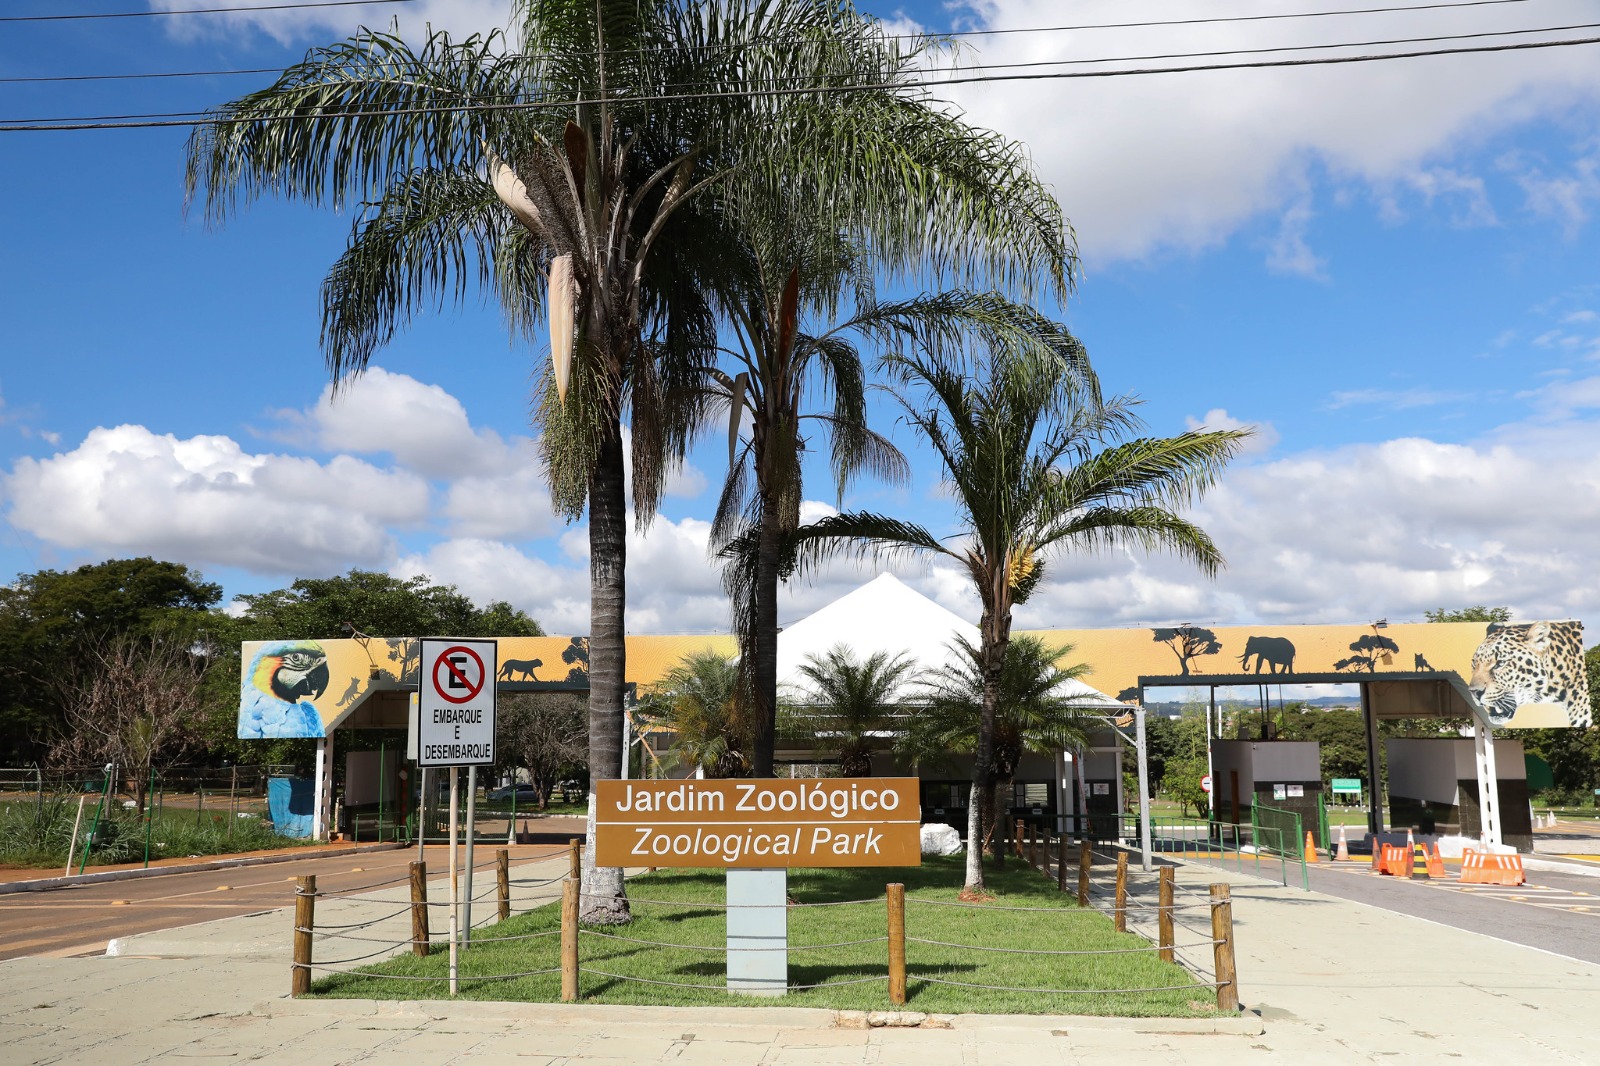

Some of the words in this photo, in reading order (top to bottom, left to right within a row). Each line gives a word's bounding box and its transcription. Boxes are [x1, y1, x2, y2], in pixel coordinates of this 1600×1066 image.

[433, 709, 482, 724] EMBARQUE
[454, 725, 461, 740] E
[425, 743, 491, 760] DESEMBARQUE
[615, 782, 725, 813] Jardim
[735, 782, 899, 819] Zoológico
[630, 827, 802, 863] Zoological
[810, 827, 884, 855] Park
